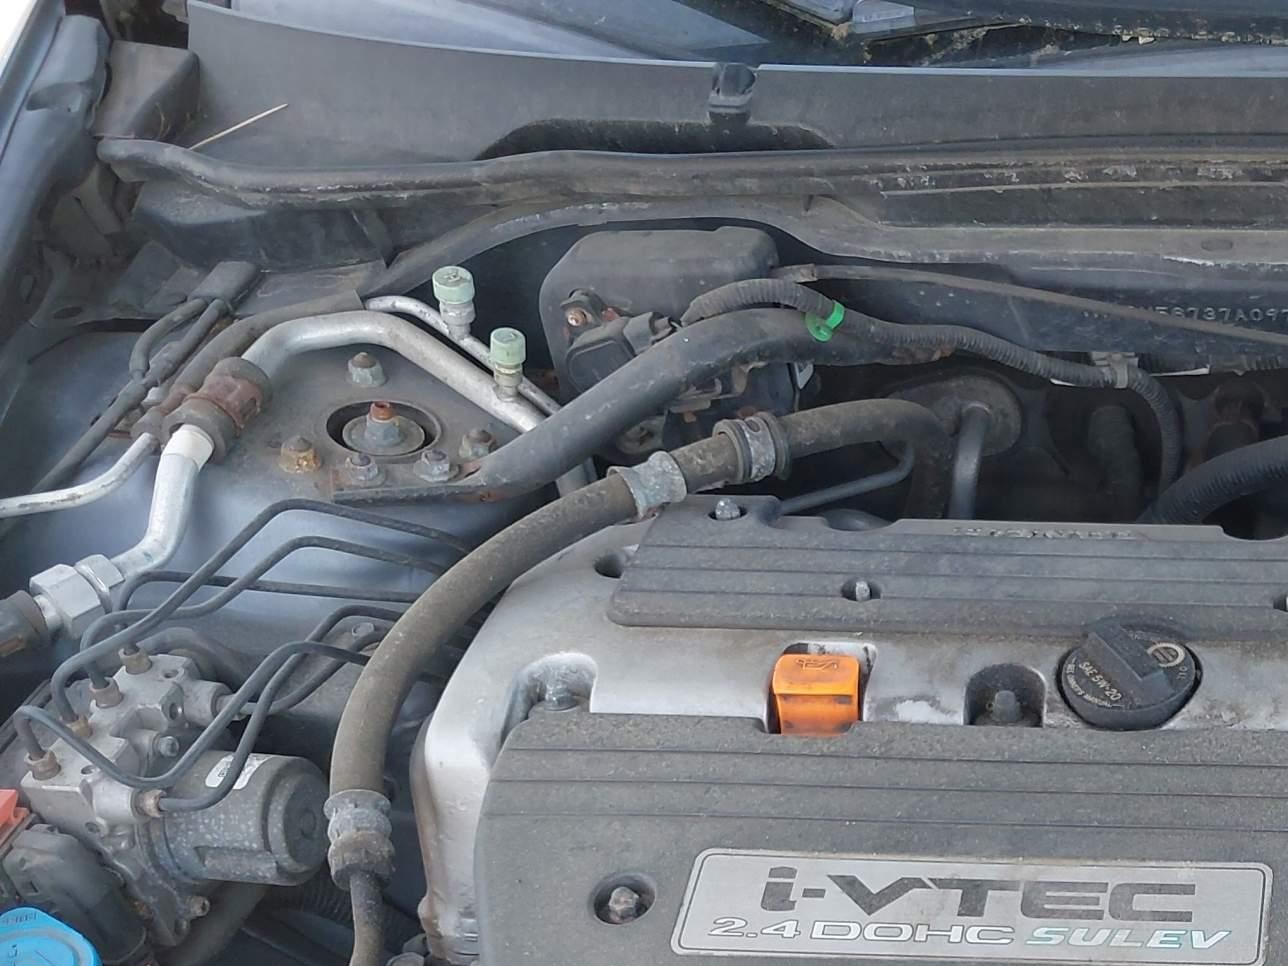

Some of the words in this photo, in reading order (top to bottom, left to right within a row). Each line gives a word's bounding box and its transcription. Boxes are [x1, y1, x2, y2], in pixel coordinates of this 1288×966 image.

[1079, 661, 1098, 677] SAE
[1092, 674, 1122, 701] 5W-20
[760, 866, 1196, 922] i-VTEC
[709, 917, 802, 940] 2.4
[810, 921, 1015, 945] DOHC
[1024, 926, 1233, 950] SULEV
